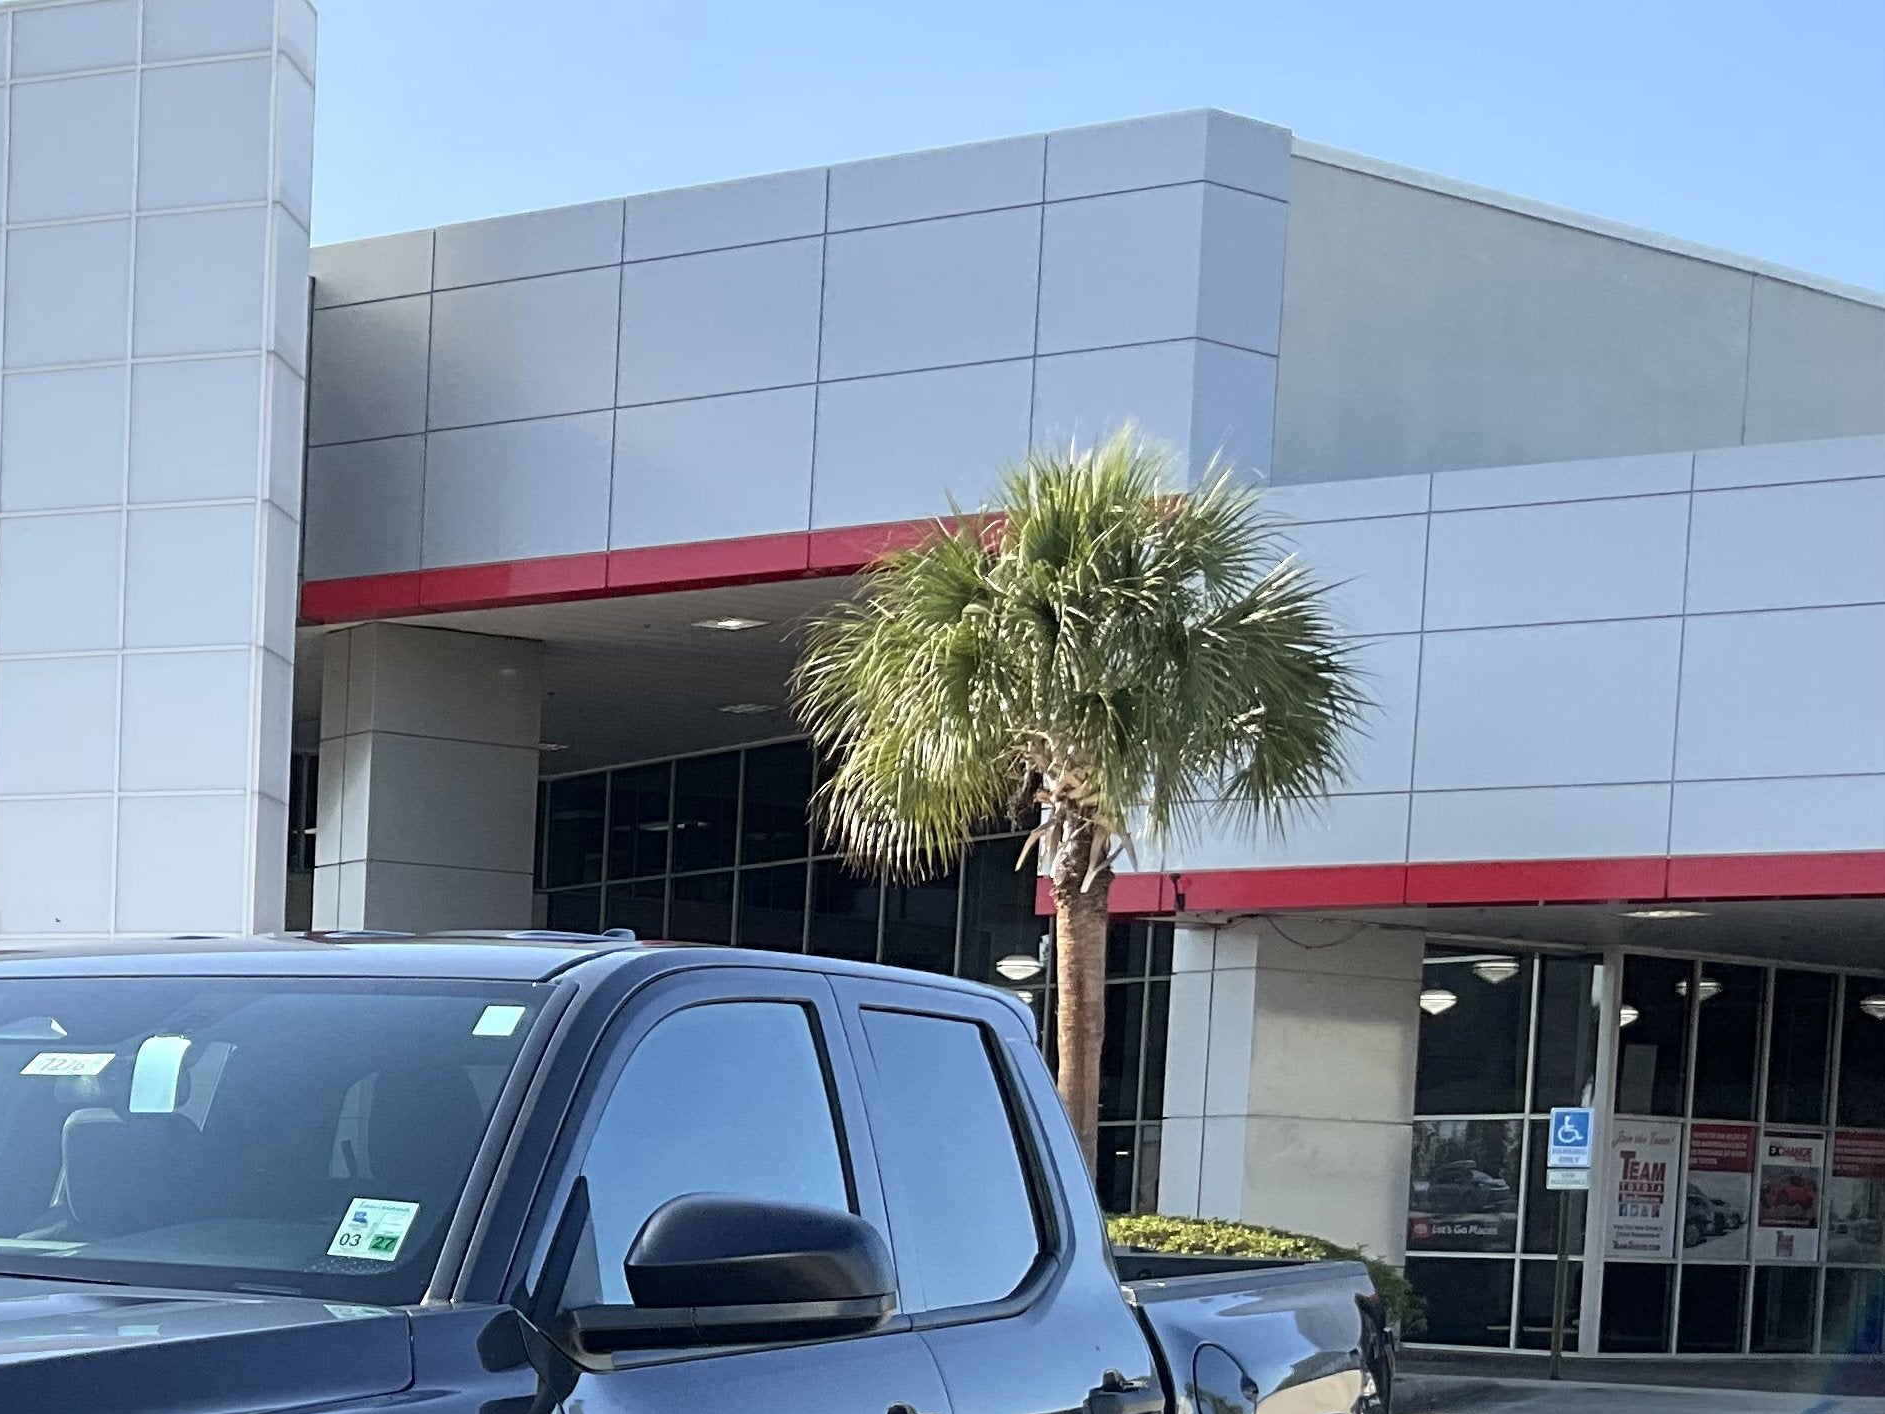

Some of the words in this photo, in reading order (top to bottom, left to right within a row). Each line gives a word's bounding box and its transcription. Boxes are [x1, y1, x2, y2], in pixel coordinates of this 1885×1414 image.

[1620, 1150, 1666, 1181] TEAM
[1621, 1182, 1663, 1193] TOYOTA
[1454, 1224, 1467, 1234] Go
[339, 1233, 362, 1247] 03
[372, 1236, 399, 1250] 27
